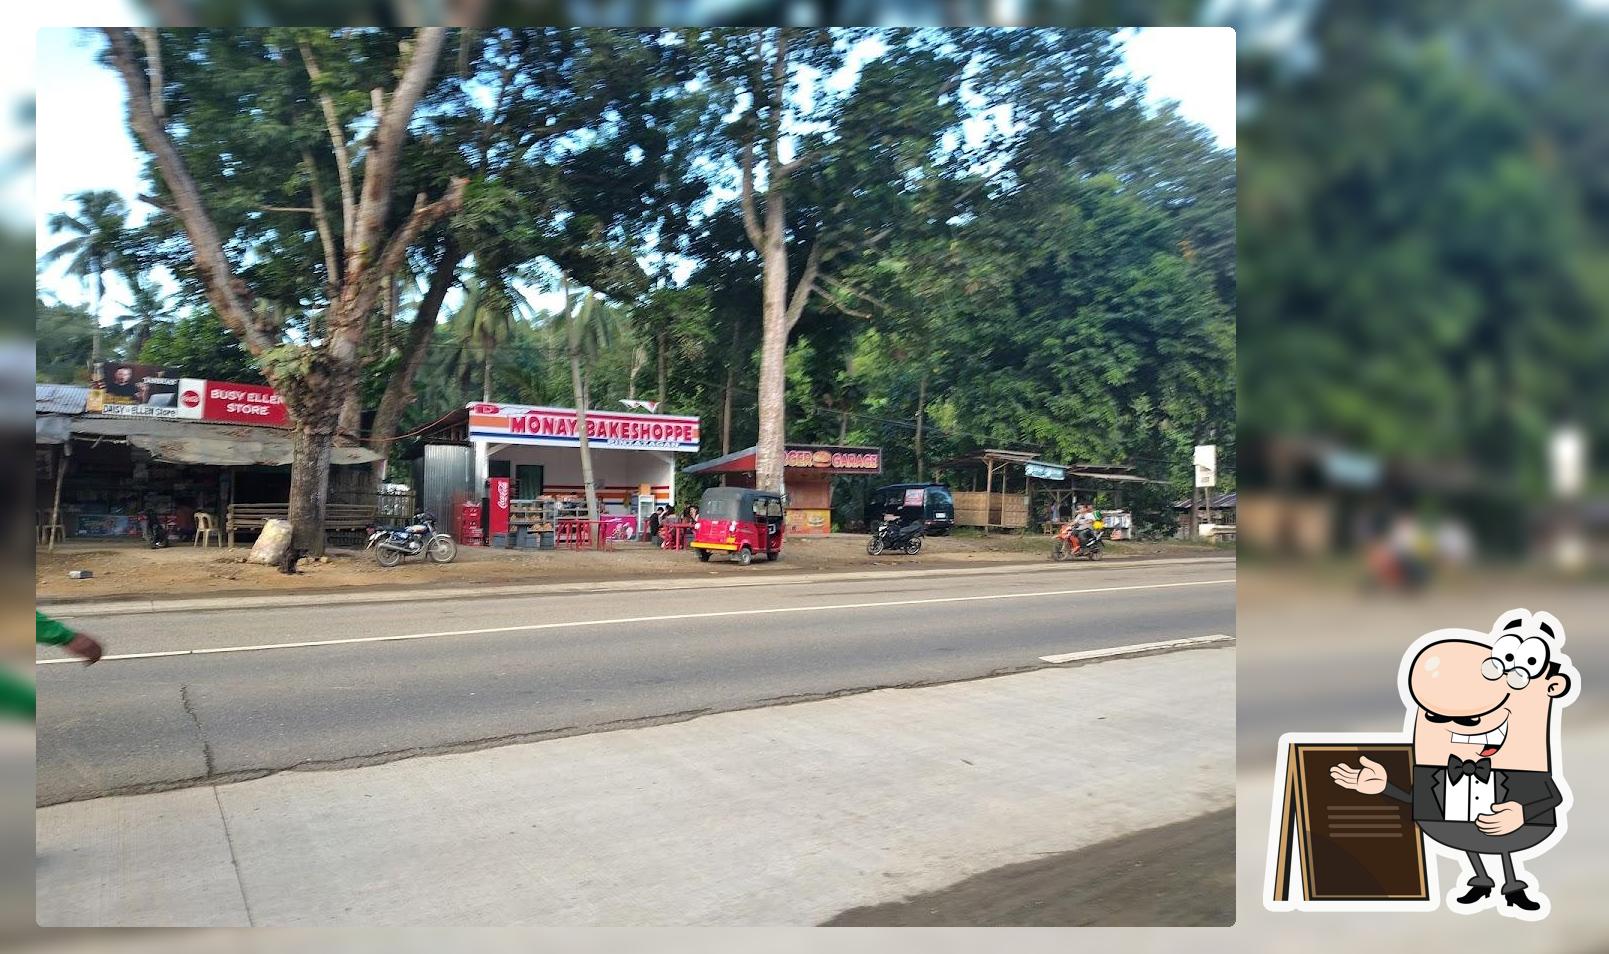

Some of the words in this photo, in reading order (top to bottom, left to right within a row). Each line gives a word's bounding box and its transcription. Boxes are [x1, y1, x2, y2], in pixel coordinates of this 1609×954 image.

[210, 388, 246, 401] BUSY
[226, 403, 270, 415] STORE
[511, 415, 577, 436] MONAY
[587, 420, 692, 442] BAKESHOPPE
[831, 452, 879, 469] GARAGE
